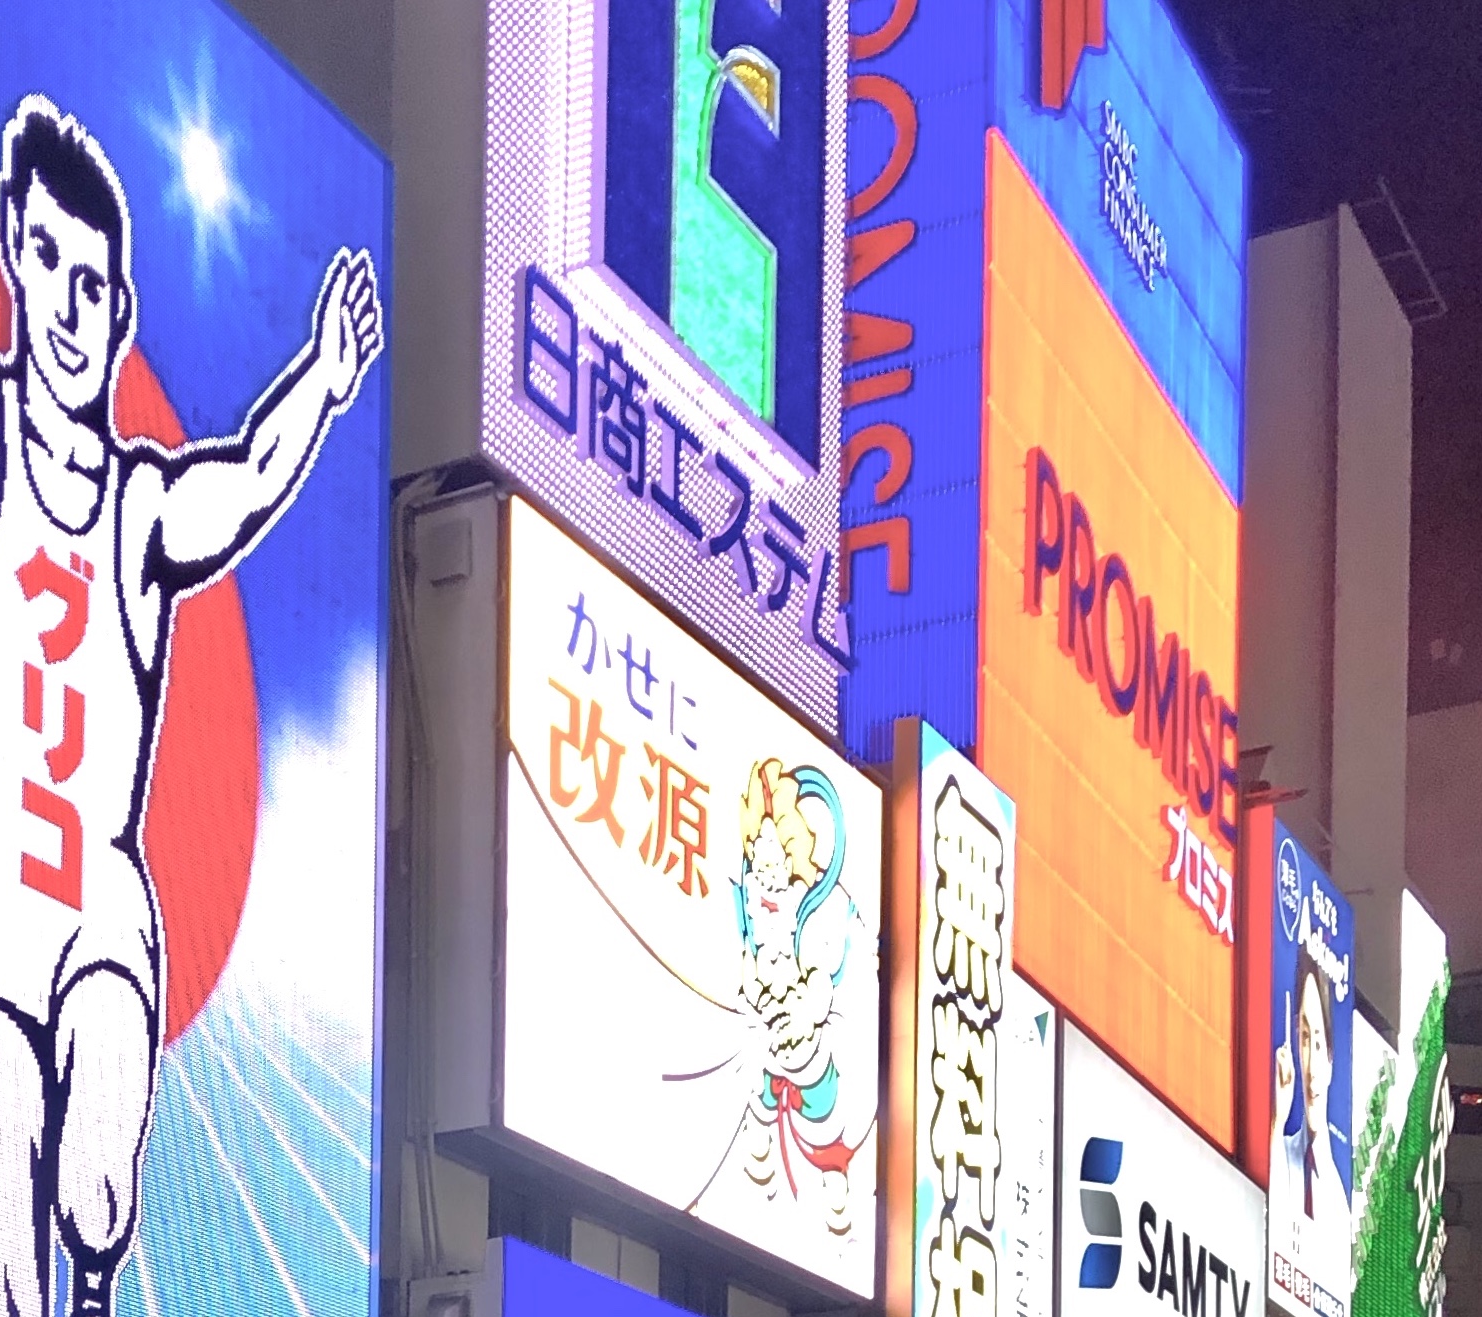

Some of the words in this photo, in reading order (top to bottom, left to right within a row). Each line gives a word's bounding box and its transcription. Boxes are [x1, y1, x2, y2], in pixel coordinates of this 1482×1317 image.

[17, 546, 95, 911] グリコ
[548, 677, 711, 898] 改源
[1024, 445, 1239, 852] PROMISE
[1162, 804, 1235, 946] プロミス
